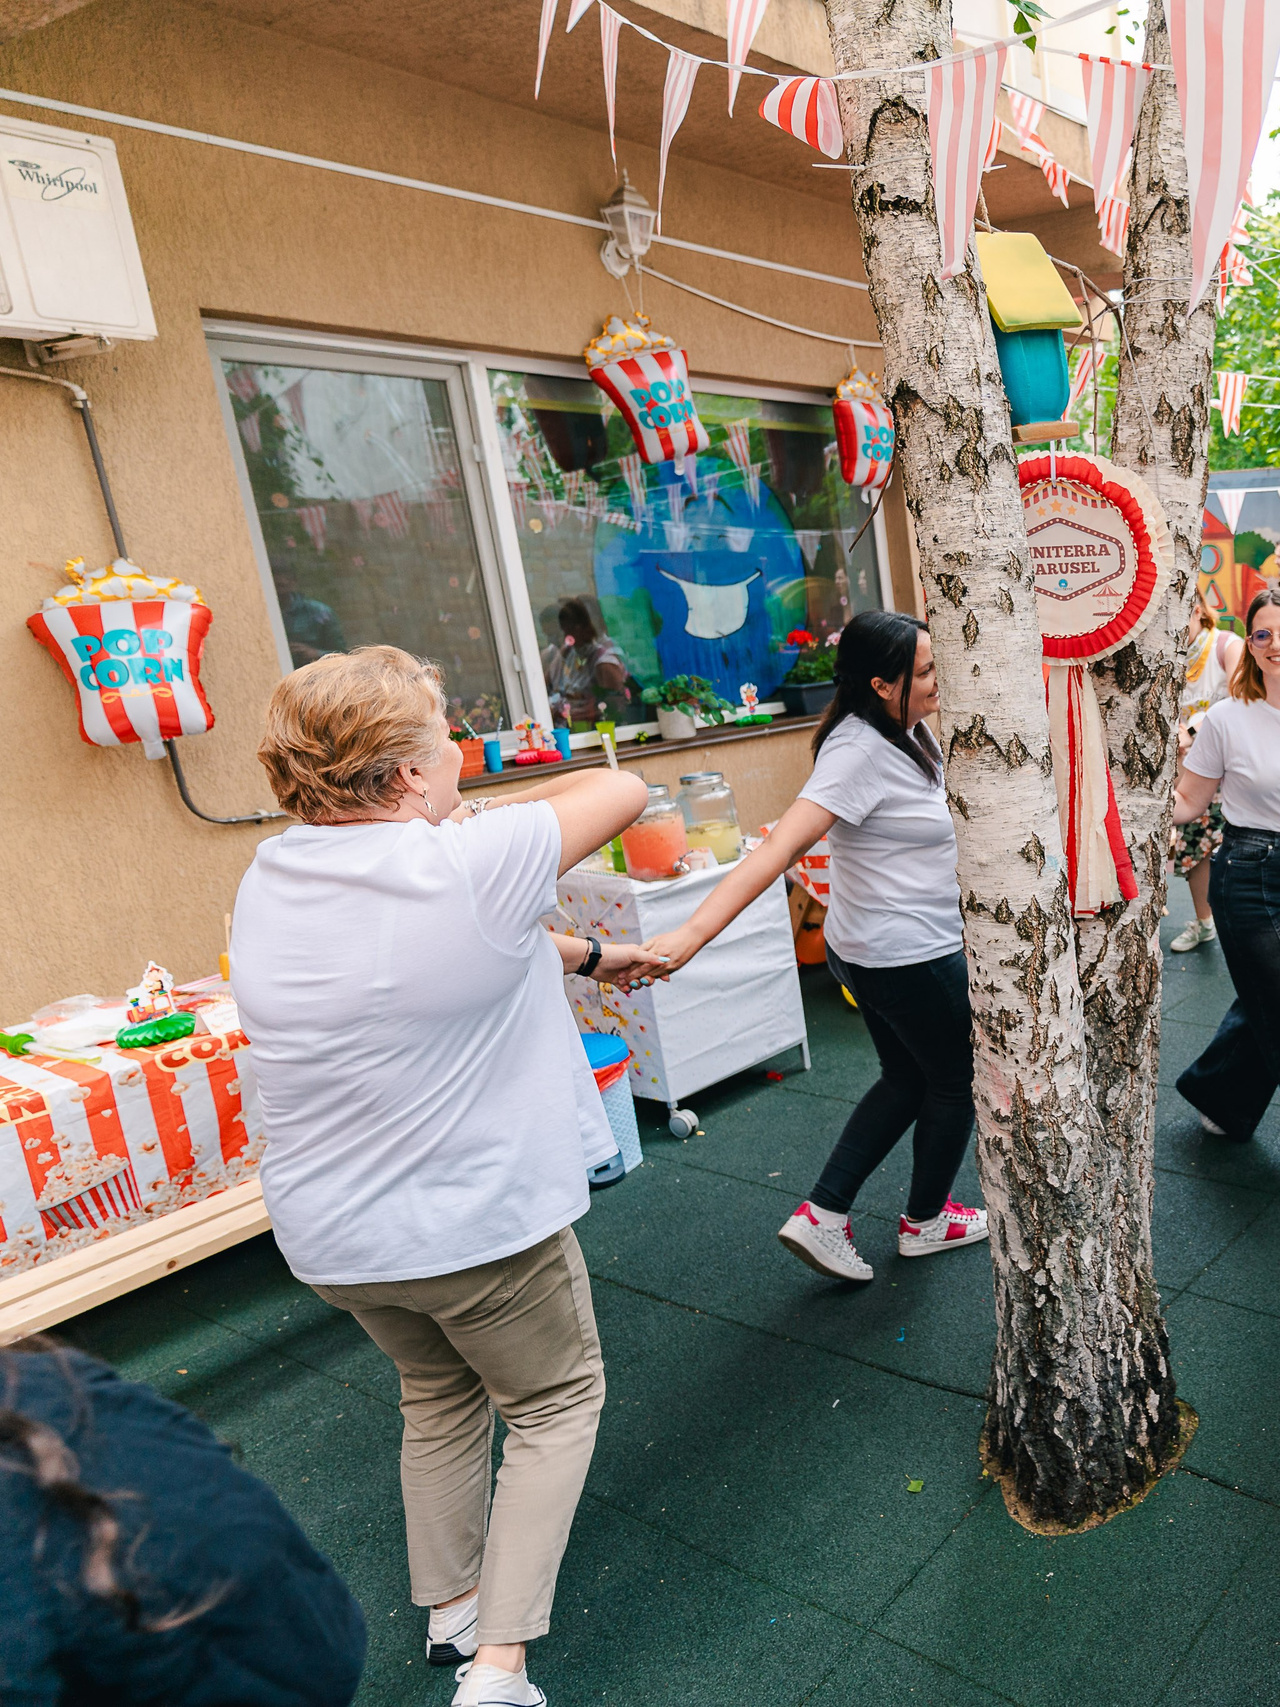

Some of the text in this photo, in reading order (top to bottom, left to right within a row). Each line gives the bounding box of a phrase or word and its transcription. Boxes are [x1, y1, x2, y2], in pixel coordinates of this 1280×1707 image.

[18, 168, 98, 195] Whirlpool
[629, 379, 685, 409] POP
[862, 443, 893, 462] COR
[1032, 562, 1100, 576] ARUSEL
[70, 628, 173, 663] POP
[79, 657, 185, 692] CORN
[158, 1029, 251, 1069] COR
